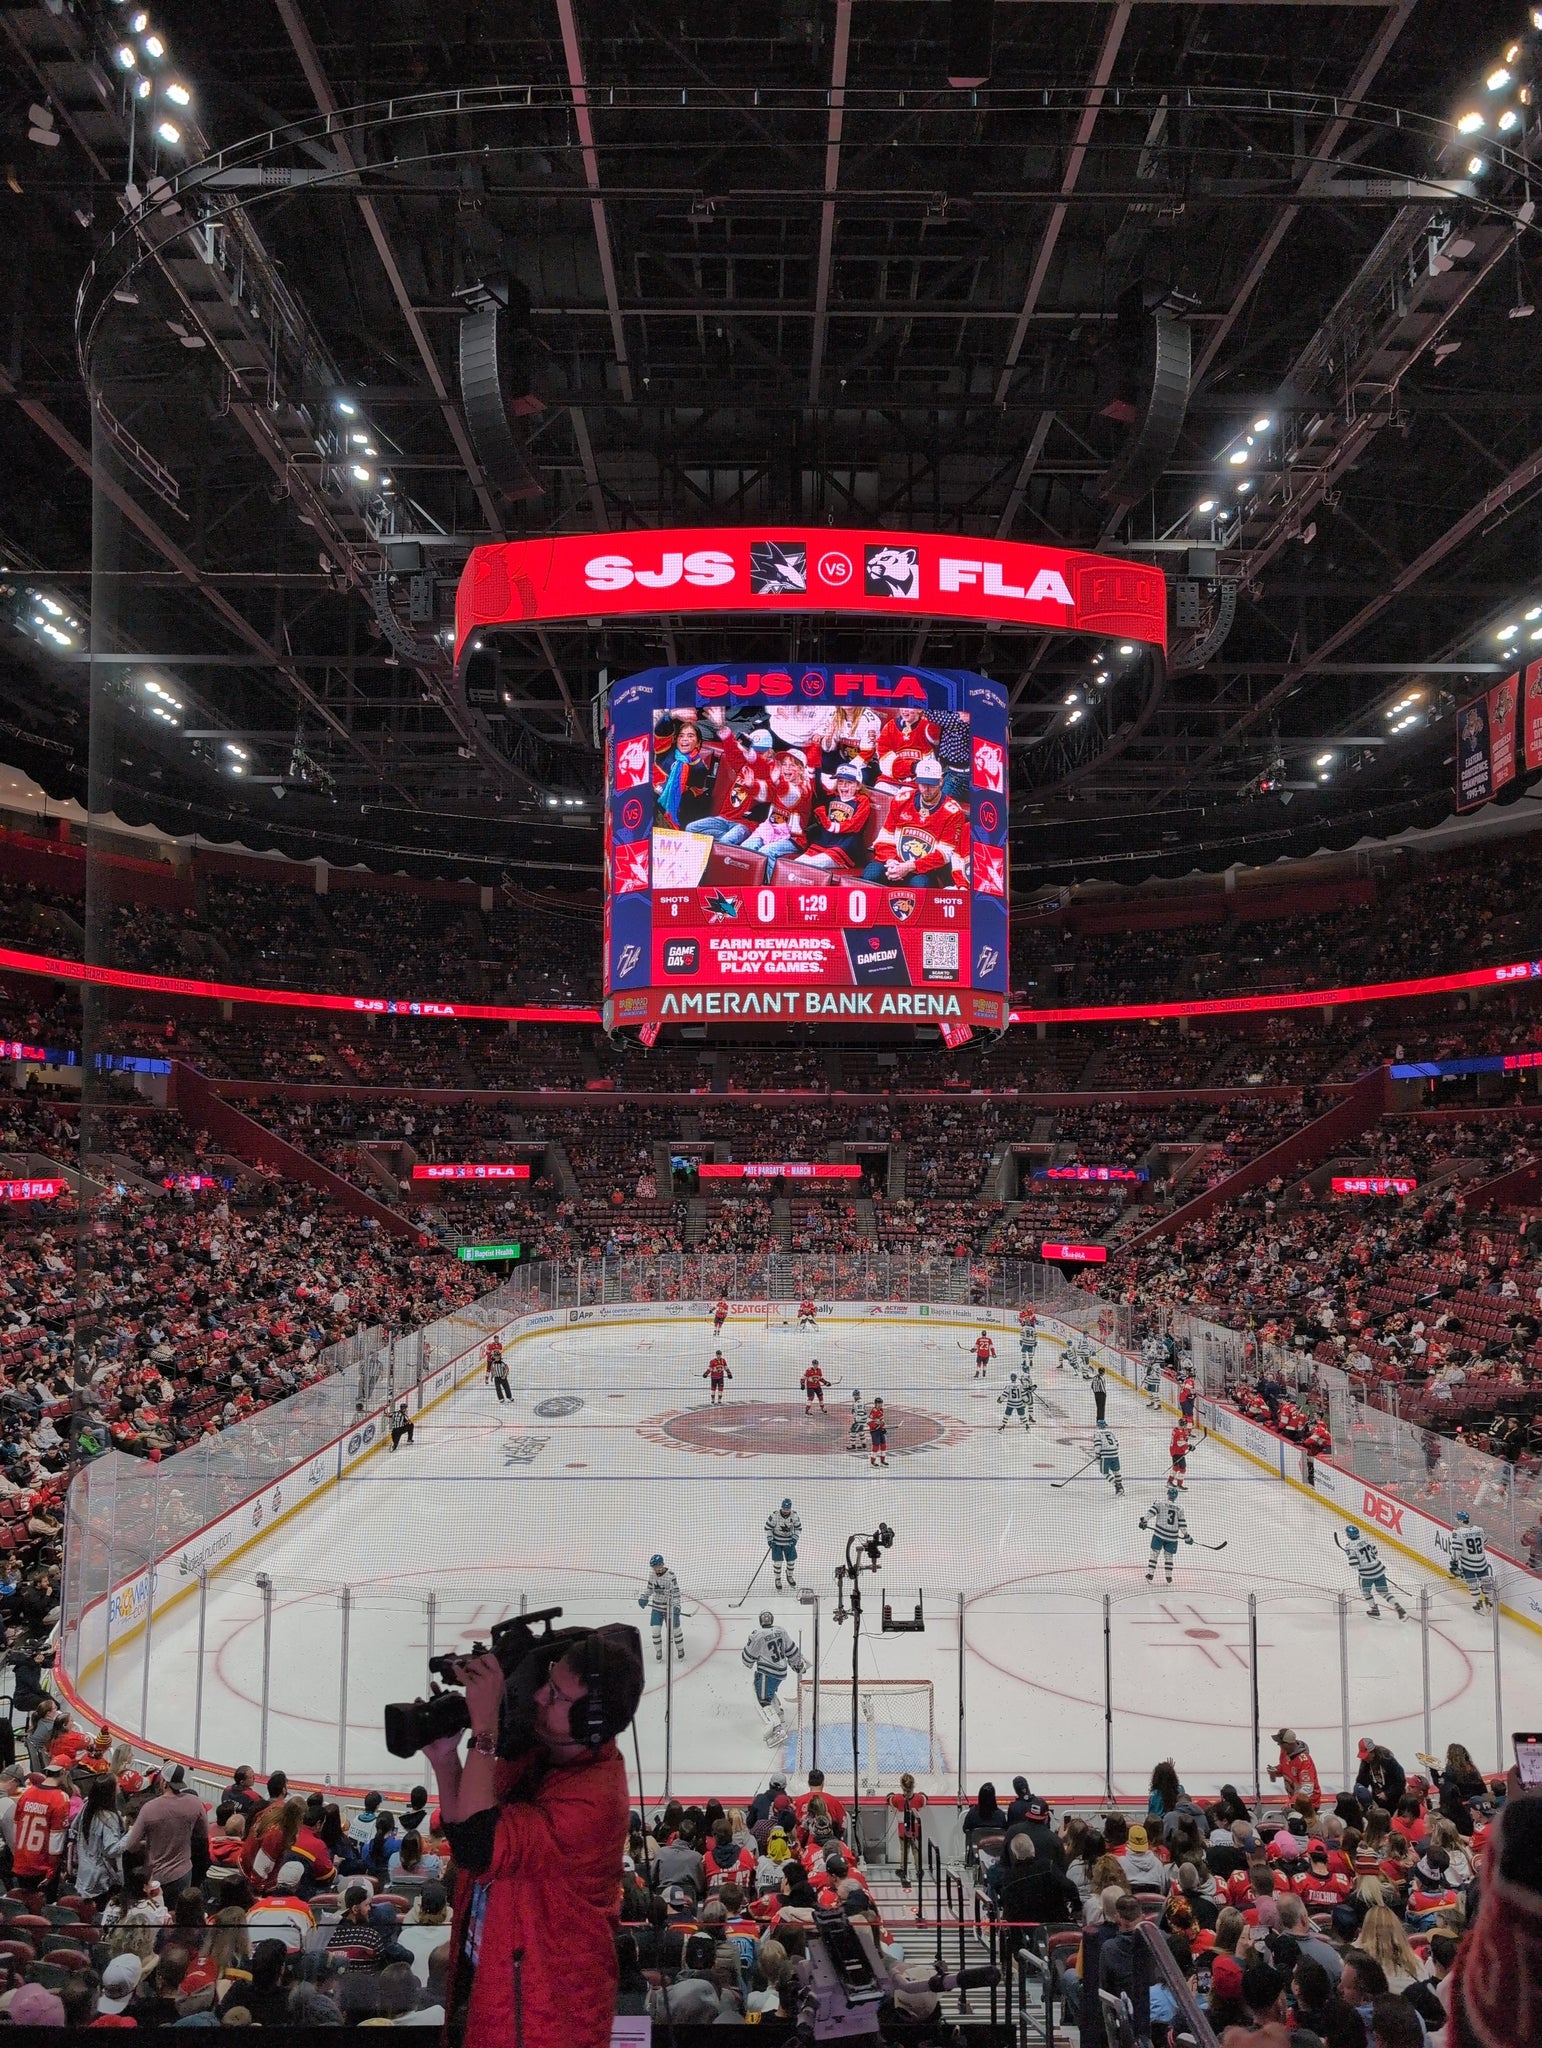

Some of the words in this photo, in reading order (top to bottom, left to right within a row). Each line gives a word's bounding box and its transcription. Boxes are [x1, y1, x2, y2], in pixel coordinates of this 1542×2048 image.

[585, 551, 736, 591] SJS
[825, 562, 846, 577] VS
[939, 557, 1075, 606] FLA
[696, 673, 793, 698] SJS
[806, 680, 820, 690] VS
[834, 674, 928, 699] FLA
[660, 896, 690, 904] SHOTS
[757, 890, 775, 923] 0
[798, 895, 827, 911] 1:29
[849, 890, 867, 923] 0
[671, 904, 678, 917] 8
[943, 906, 955, 918] 10
[710, 938, 751, 950] EARN
[754, 938, 835, 950] REWARDS.
[669, 946, 695, 957] GAME
[717, 950, 772, 962] ENJOY
[775, 949, 828, 962] PERKS.
[857, 949, 897, 965] GAMEDAY
[720, 961, 761, 973] PLAY
[764, 961, 823, 973] GAMES.
[1495, 965, 1527, 980] SJS
[354, 1000, 384, 1010] SJS
[424, 1005, 455, 1014] FLA
[660, 992, 800, 1015] AMERANT
[806, 992, 873, 1015] BANK
[880, 993, 962, 1017] ARENA
[428, 1167, 454, 1176] SJS
[488, 1167, 515, 1176] FLA
[32, 1183, 54, 1195] FLA
[1344, 1181, 1368, 1191] SJS
[731, 1303, 780, 1315] SEATGEEK
[931, 1308, 952, 1319] Baptist
[955, 1310, 972, 1318] Health
[529, 1315, 554, 1326] HONDA
[980, 1341, 988, 1349] 23
[1010, 1388, 1020, 1399] 51
[1106, 1435, 1112, 1446] 5
[1167, 1509, 1176, 1526] 3
[1363, 1490, 1404, 1535] DEX
[1465, 1538, 1482, 1555] 92
[121, 1769, 134, 1782] 72
[17, 1815, 47, 1852] 16
